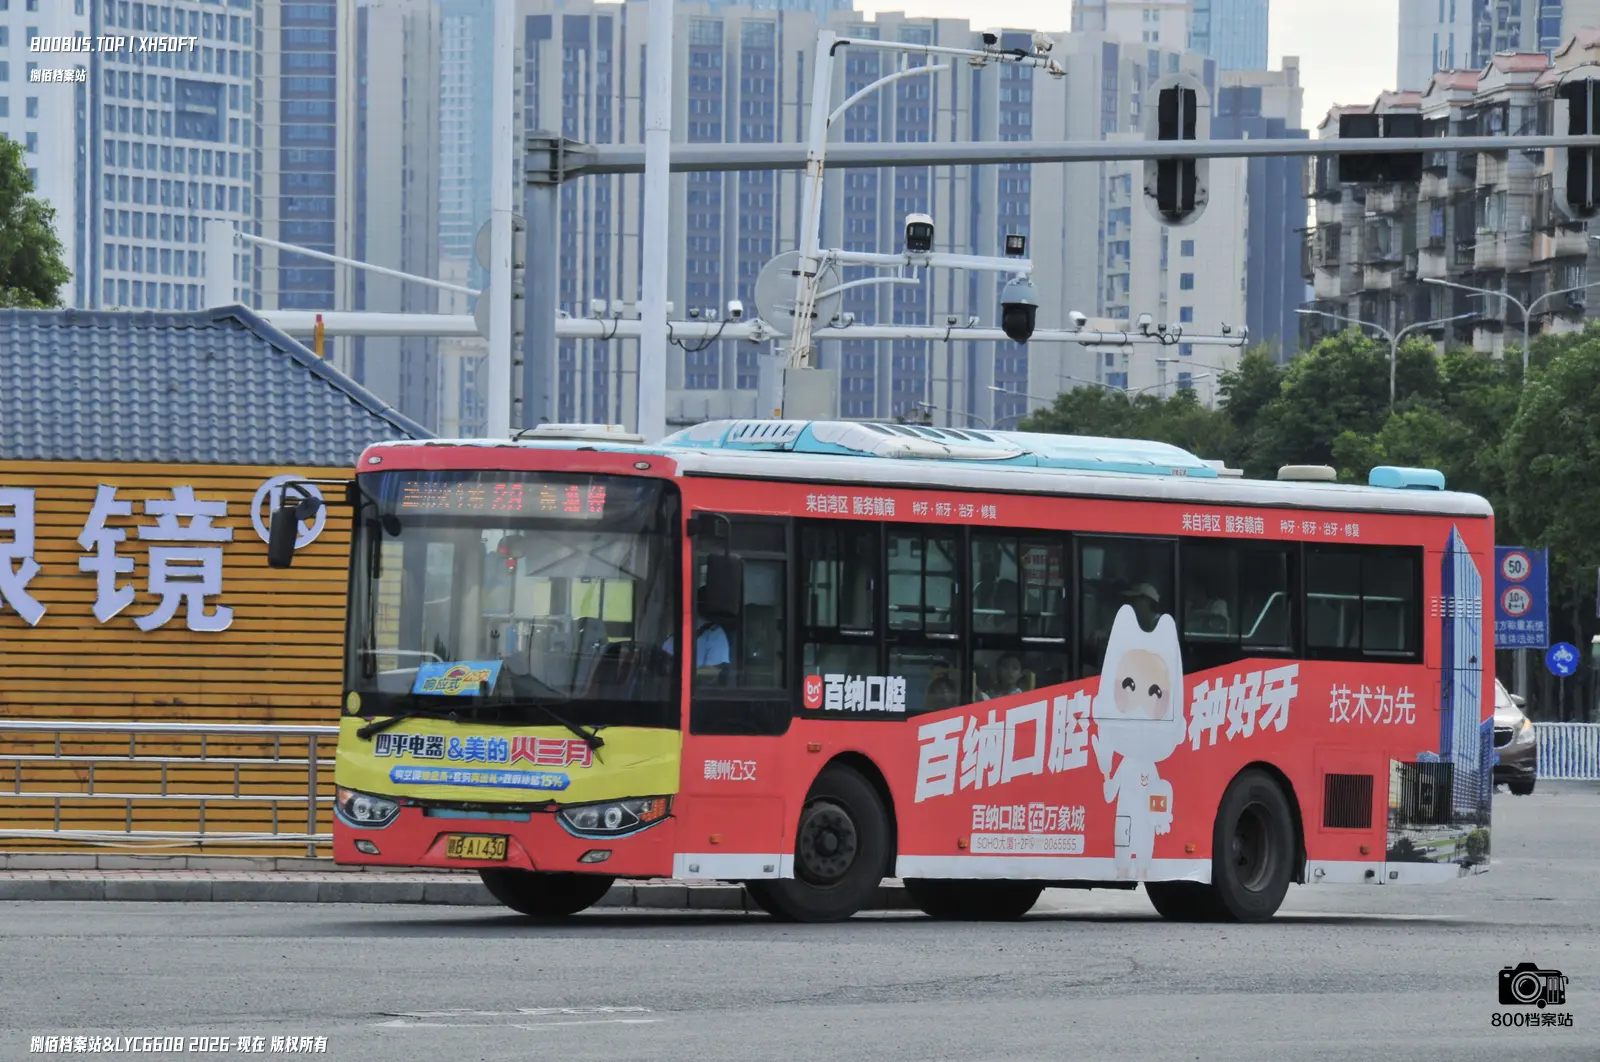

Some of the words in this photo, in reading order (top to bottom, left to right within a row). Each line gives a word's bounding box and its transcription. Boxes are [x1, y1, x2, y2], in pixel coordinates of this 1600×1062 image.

[806, 492, 849, 513] 来自湾区
[853, 496, 896, 516] 服务赣南
[1182, 512, 1221, 532] 来自湾区
[1225, 515, 1265, 534] 服务赣南
[824, 673, 907, 712] 百纳口腔
[1329, 684, 1416, 725] 技术为先
[914, 689, 1093, 803] 百纳口腔
[1188, 664, 1299, 751] 种好牙
[704, 759, 757, 780] 赣州公交
